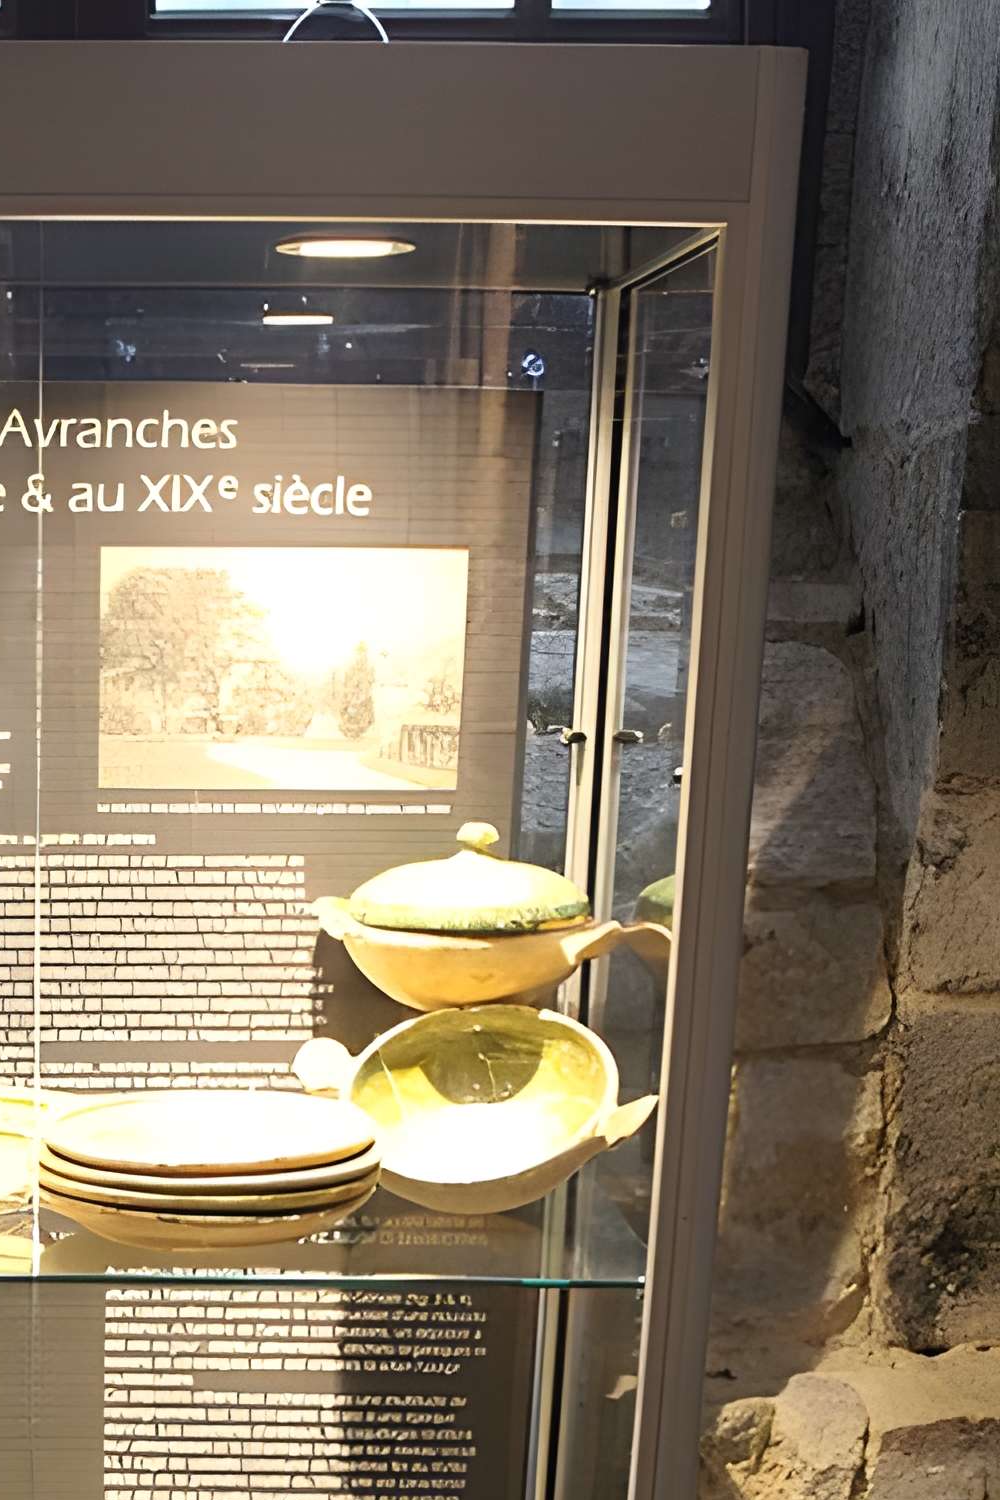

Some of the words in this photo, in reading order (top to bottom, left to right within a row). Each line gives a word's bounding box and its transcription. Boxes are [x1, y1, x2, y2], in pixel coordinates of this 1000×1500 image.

[20, 472, 55, 515] &
[67, 482, 125, 514] au
[251, 473, 373, 517] siècle
